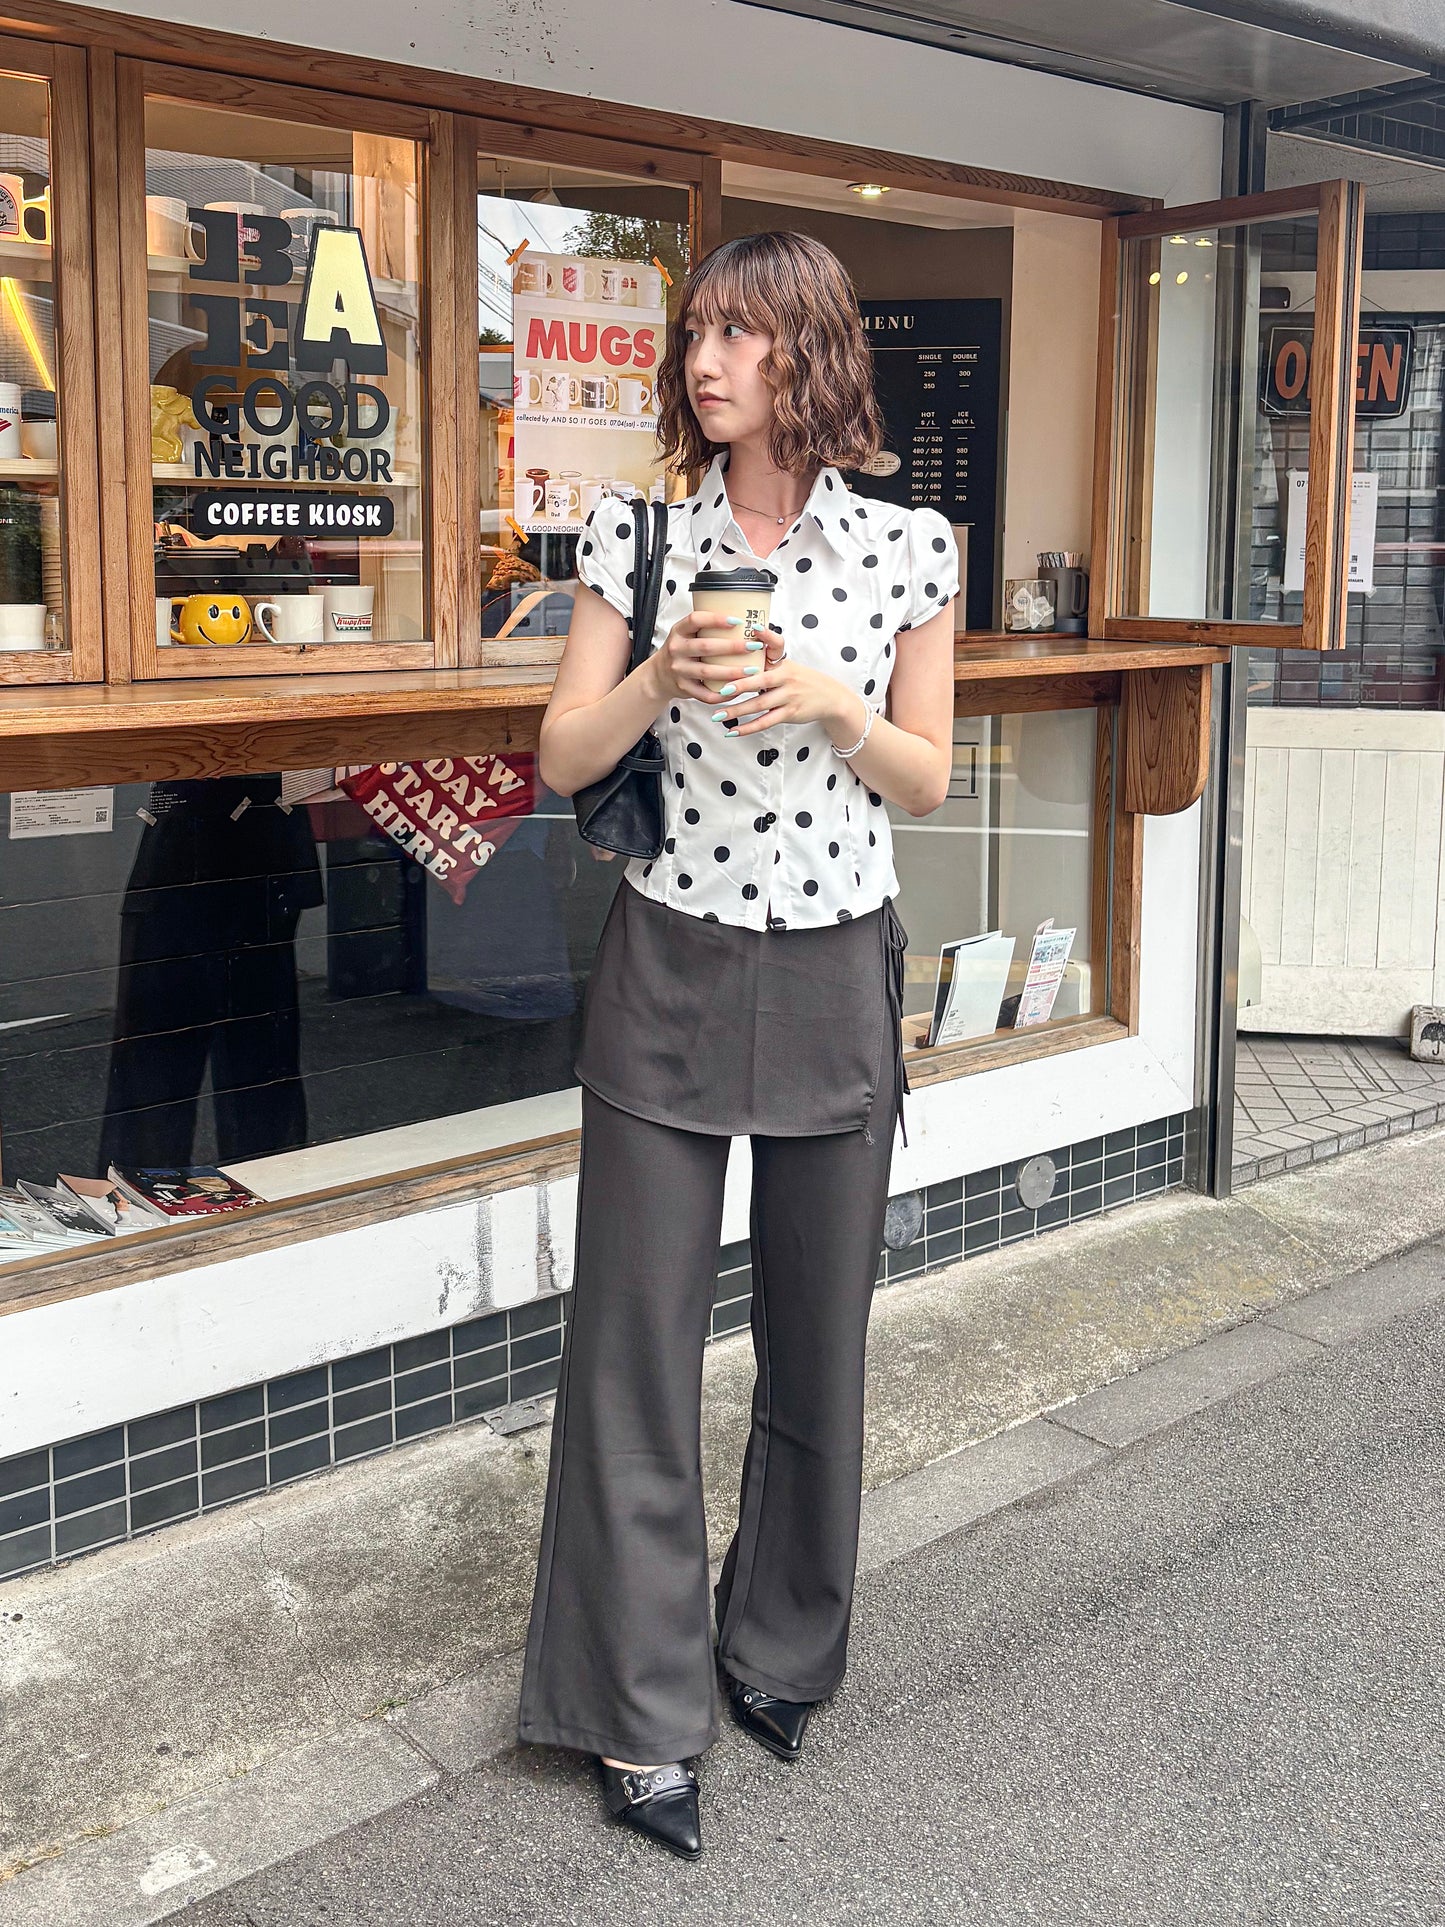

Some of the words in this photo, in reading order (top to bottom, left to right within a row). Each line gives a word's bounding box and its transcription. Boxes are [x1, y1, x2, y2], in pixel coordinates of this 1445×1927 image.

[300, 222, 389, 376] A
[859, 315, 915, 330] MENU
[526, 318, 657, 369] MUGS
[1274, 340, 1402, 402] OEN
[0, 406, 19, 415] merica
[191, 374, 390, 439] GOOD
[516, 414, 542, 423] collected
[542, 415, 550, 425] by
[569, 417, 578, 425] SO
[588, 418, 607, 426] GOES
[193, 440, 393, 483] NEIGHBOR
[207, 501, 300, 526] COFFEE
[308, 502, 382, 527] KIOSK
[422, 757, 498, 818] DAY
[463, 753, 526, 795] EW
[362, 789, 458, 881] HERE
